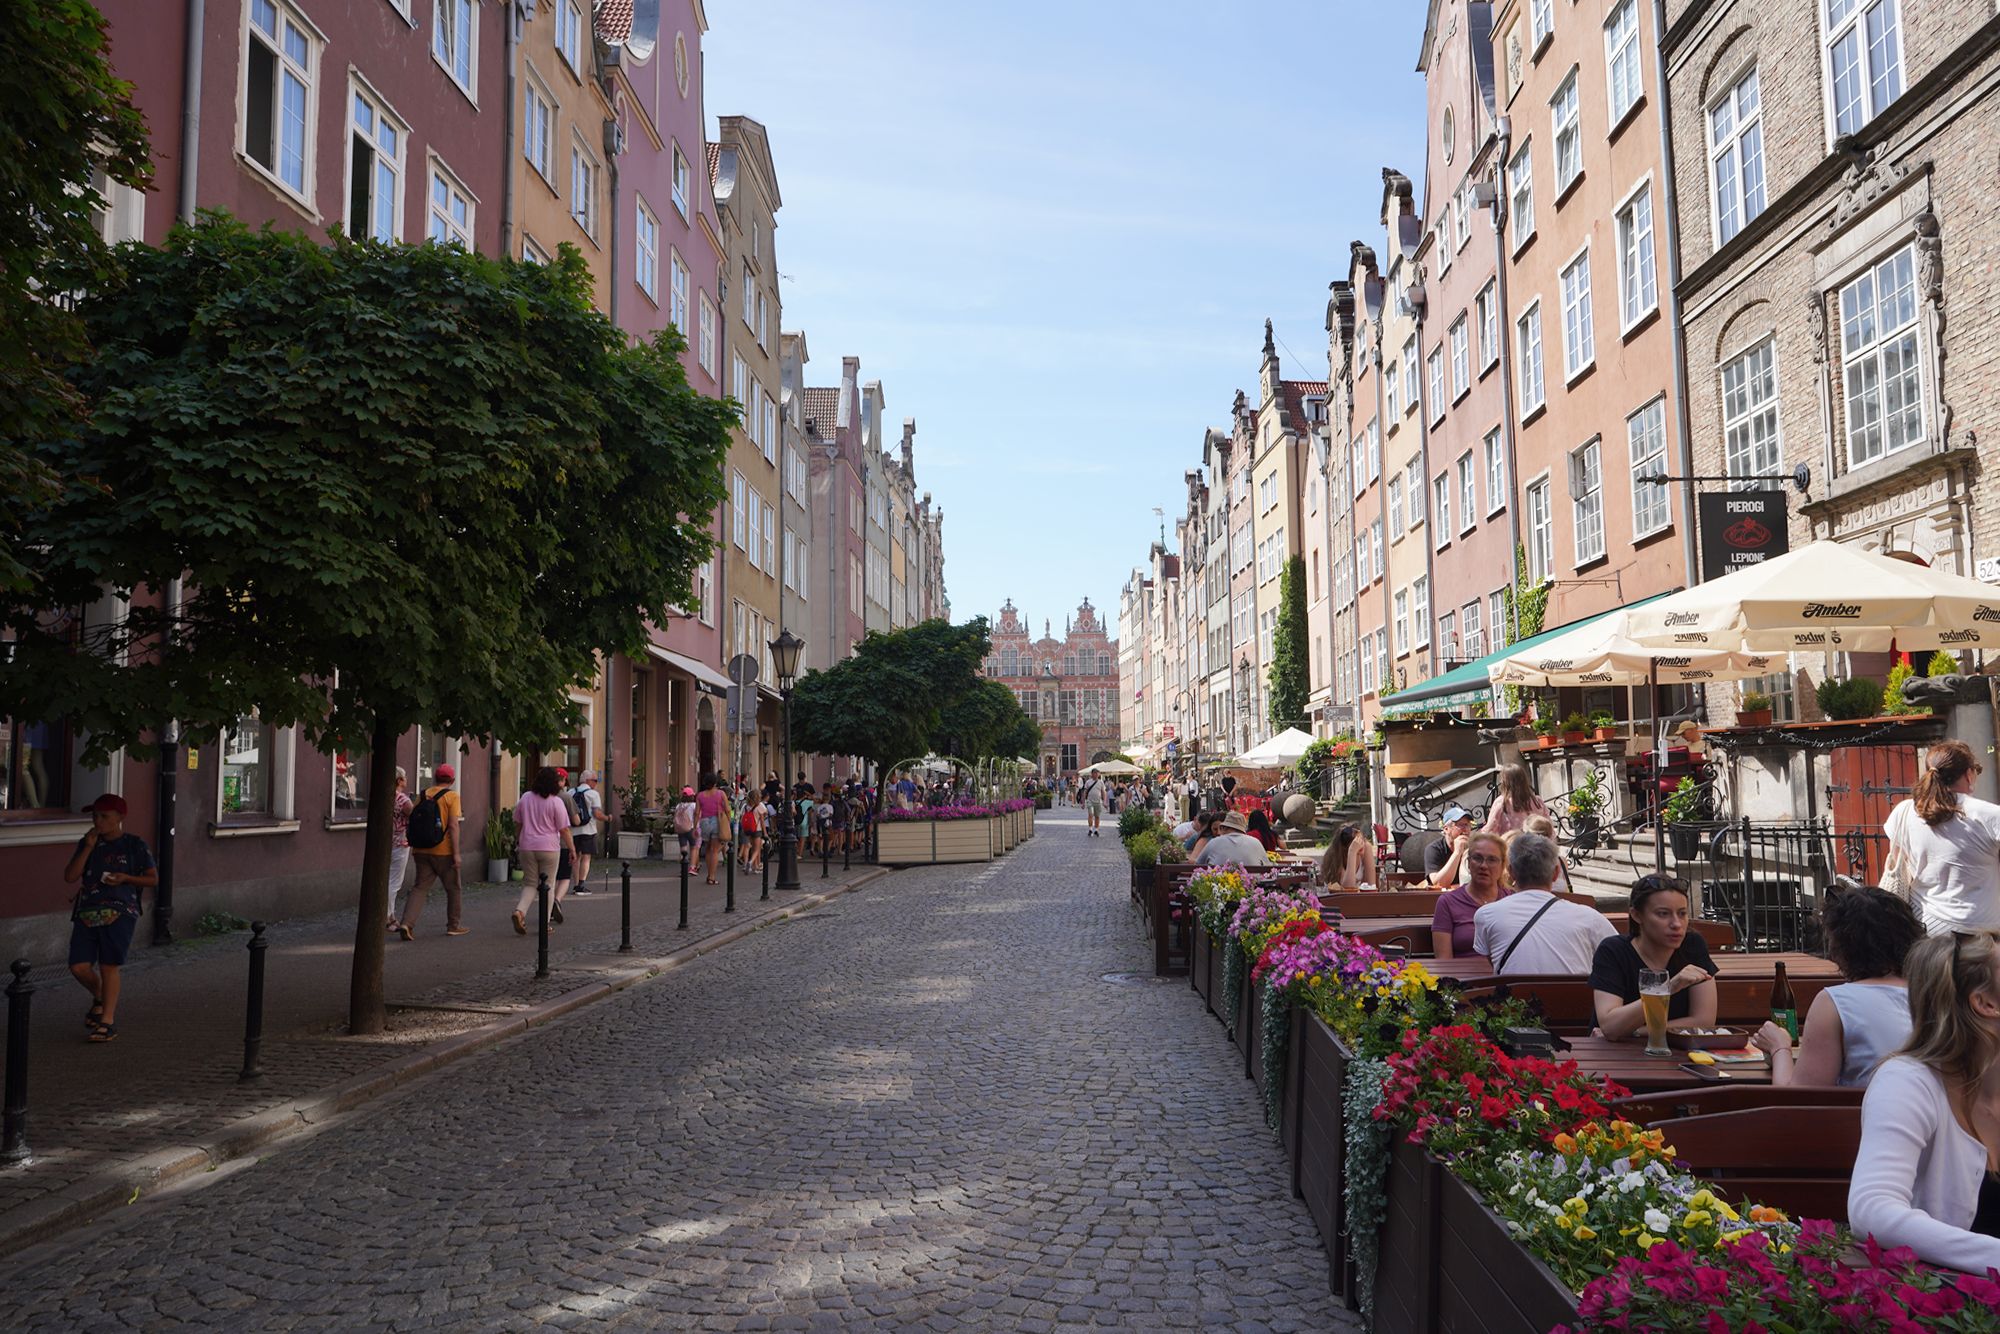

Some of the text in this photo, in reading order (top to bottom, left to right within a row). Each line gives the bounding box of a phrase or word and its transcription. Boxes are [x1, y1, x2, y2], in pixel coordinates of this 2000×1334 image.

[1726, 501, 1765, 513] PIEROGI
[1731, 552, 1766, 563] LEPIONE
[1802, 602, 1862, 618] Amber
[1664, 611, 1700, 627] Amber
[1539, 659, 1573, 670] Amber
[1655, 656, 1692, 668] Amber
